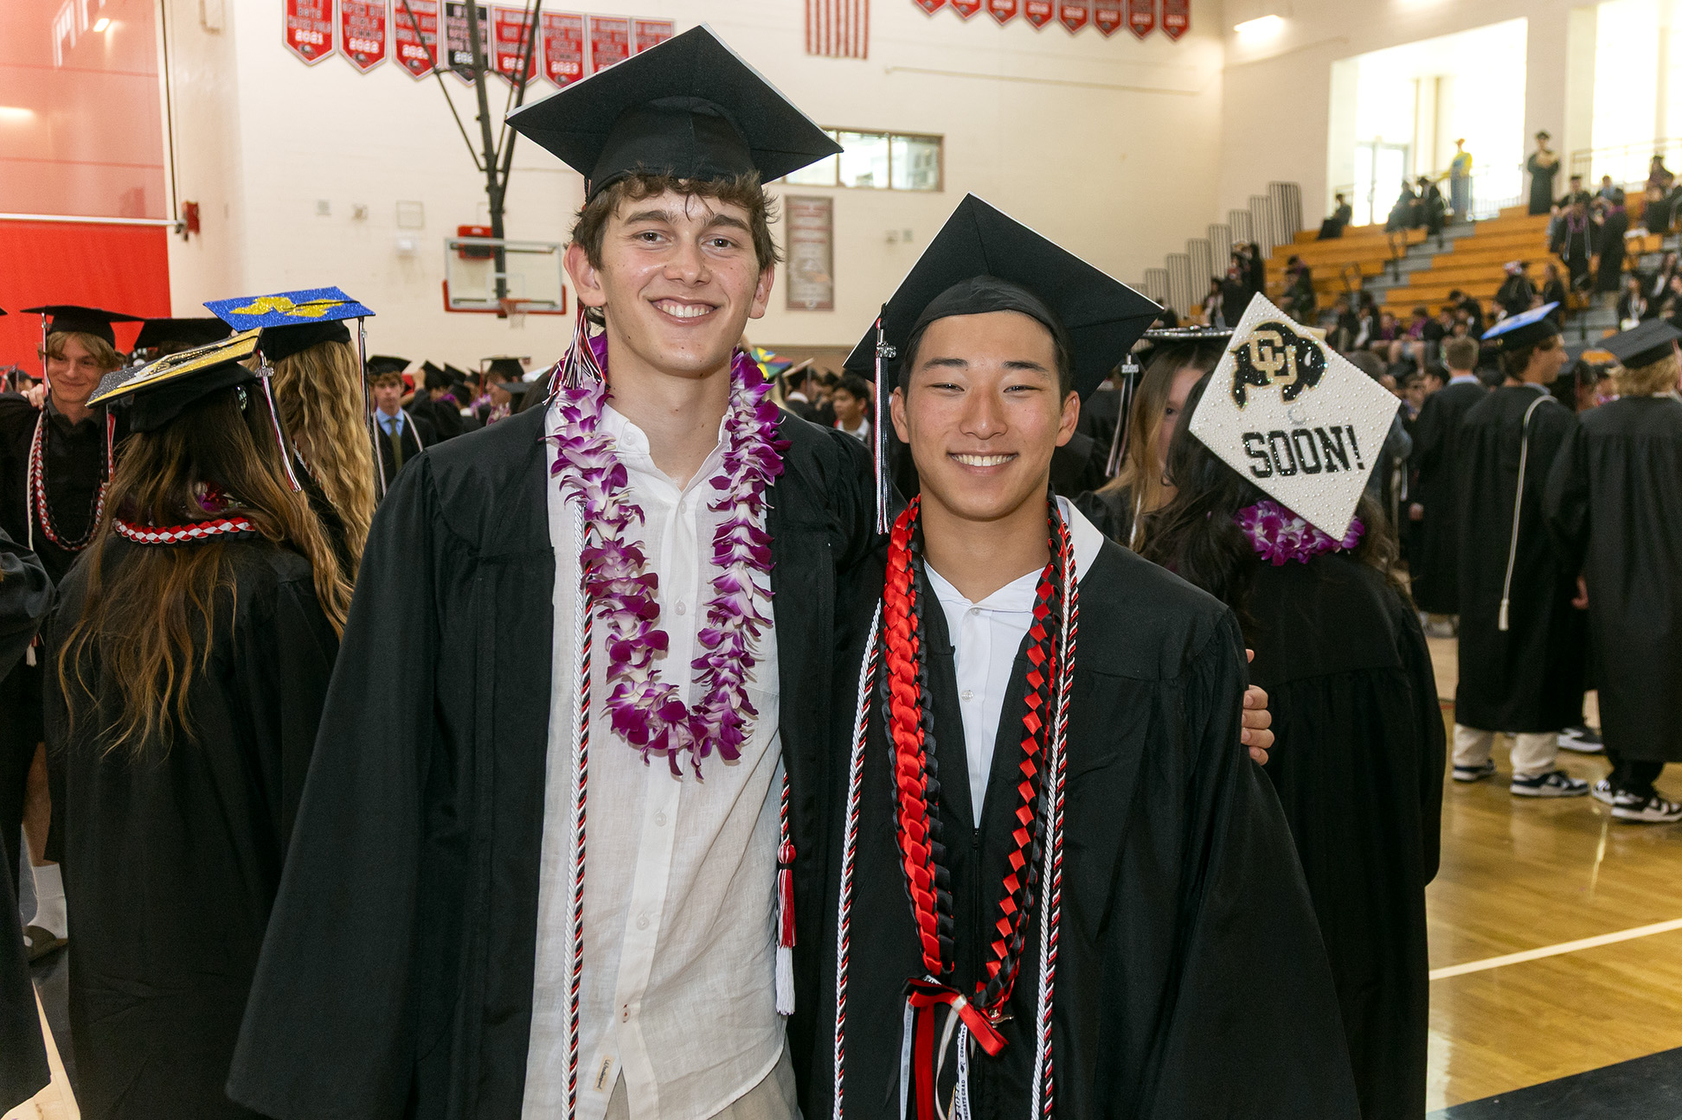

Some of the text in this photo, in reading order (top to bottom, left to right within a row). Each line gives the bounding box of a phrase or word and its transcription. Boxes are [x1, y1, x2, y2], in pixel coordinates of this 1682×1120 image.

[295, 29, 324, 45] 2021
[348, 37, 379, 53] 2022
[1250, 329, 1298, 386] CU
[1241, 424, 1366, 479] SOON!
